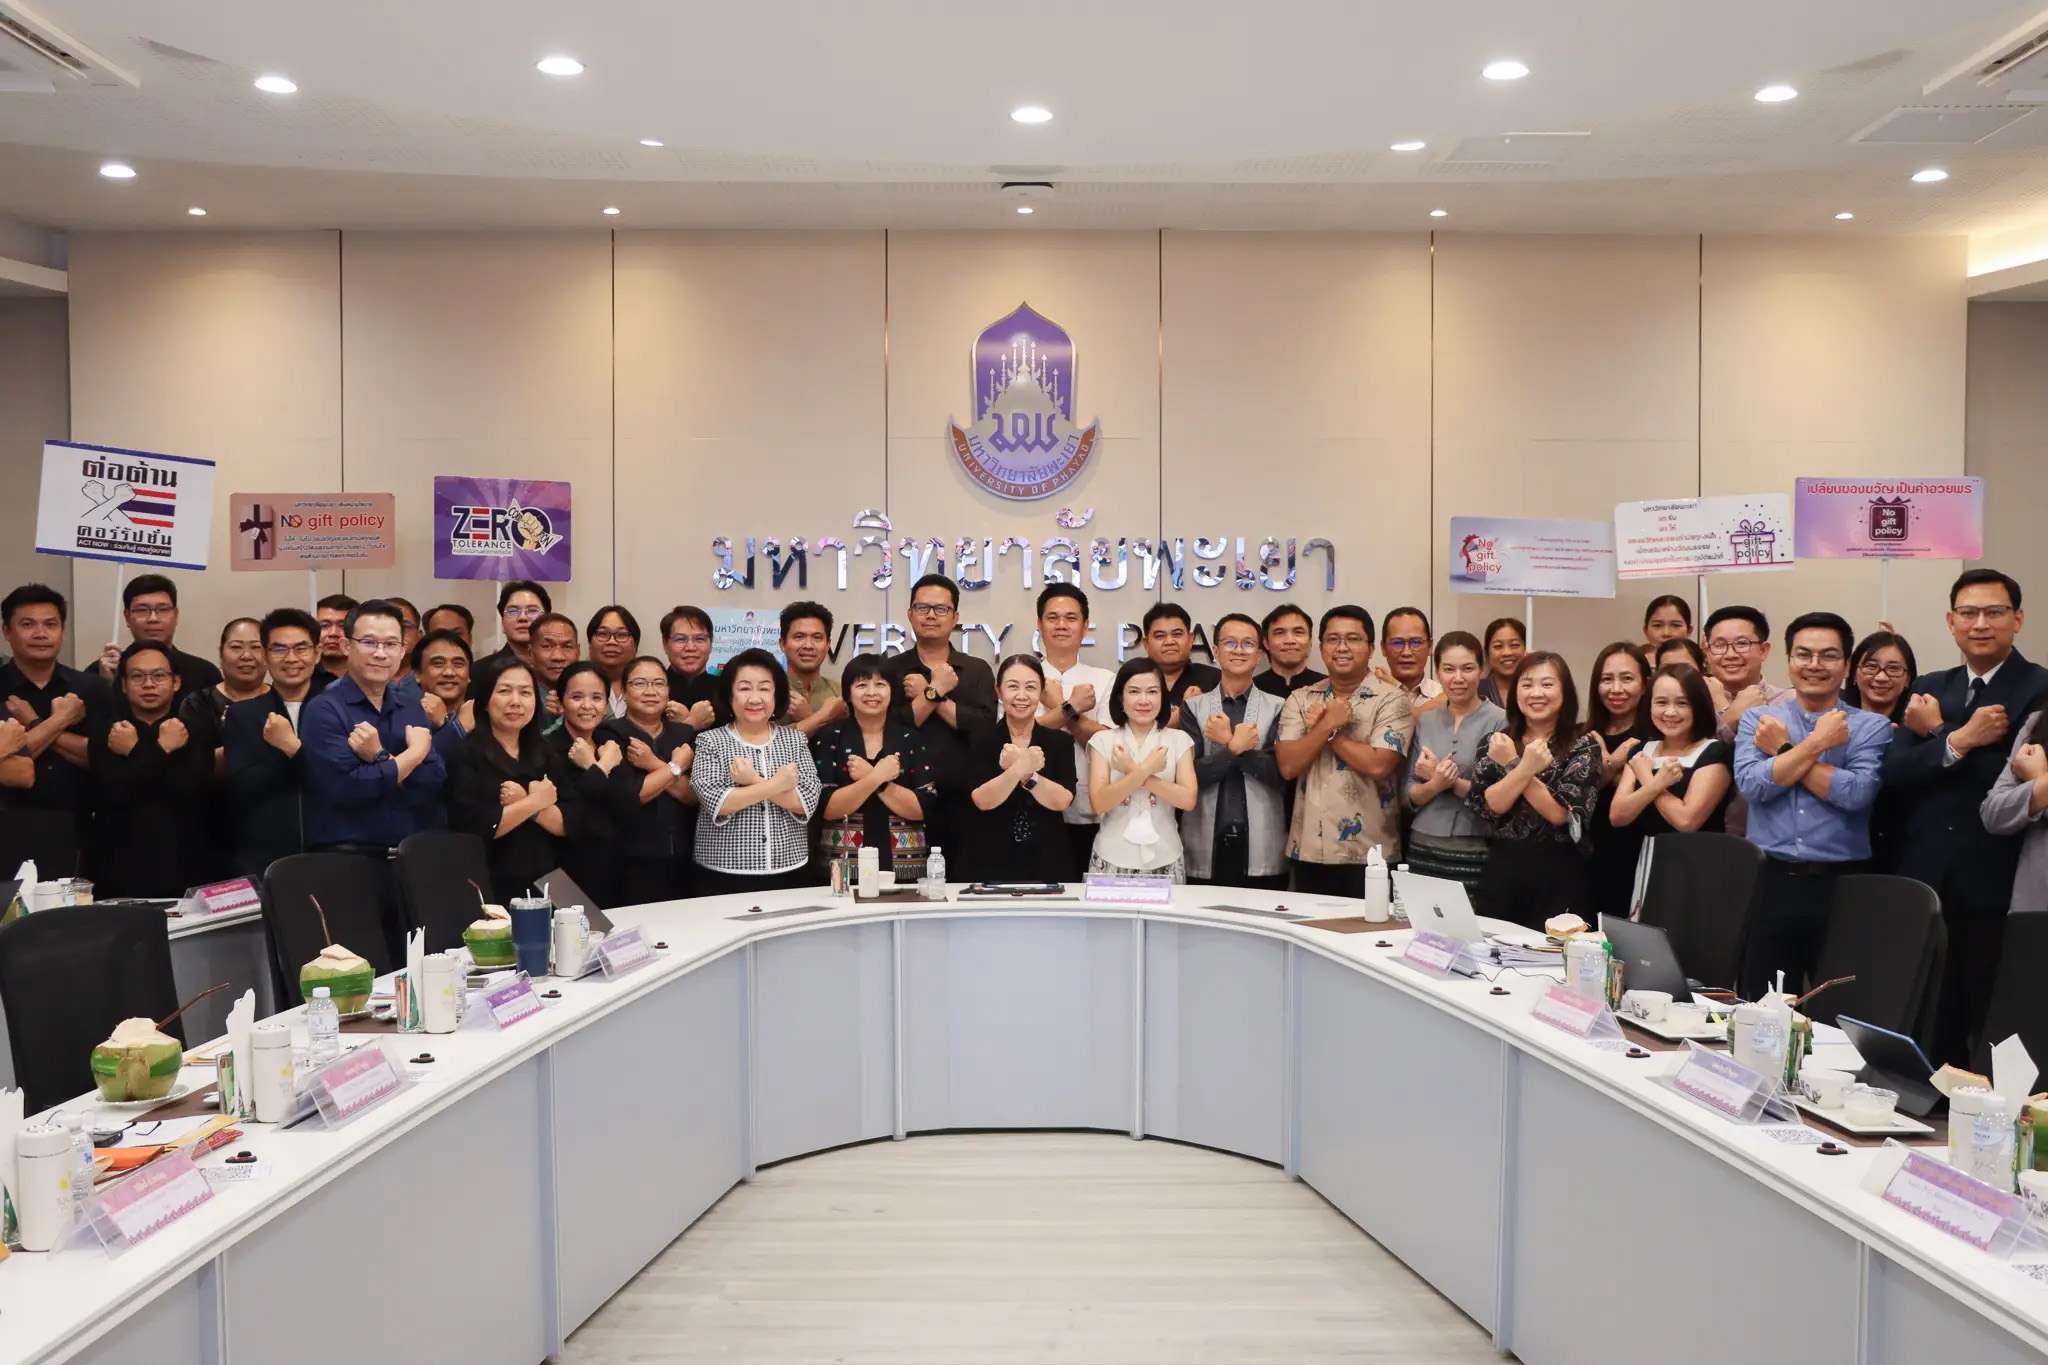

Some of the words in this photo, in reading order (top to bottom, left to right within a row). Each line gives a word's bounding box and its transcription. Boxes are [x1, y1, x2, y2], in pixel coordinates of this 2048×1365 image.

[82, 456, 178, 488] ต่อต้าน
[957, 443, 1025, 495] UNIVERSITY
[1031, 483, 1048, 495] OF
[1052, 443, 1089, 487] PHAYAO
[1882, 508, 1896, 517] No
[308, 514, 333, 531] gift
[340, 513, 385, 529] policy
[1881, 517, 1897, 526] gift
[1743, 524, 1760, 534] No
[1874, 526, 1903, 536] policy
[92, 540, 109, 548] NOW
[452, 539, 512, 549] TOLERANCE
[1478, 538, 1494, 550] No
[1743, 535, 1763, 547] gift
[712, 507, 1336, 591] มหาวิทยาลัยพะเยา
[1737, 546, 1770, 559] policy
[1476, 551, 1495, 561] gift
[1469, 562, 1502, 574] policy
